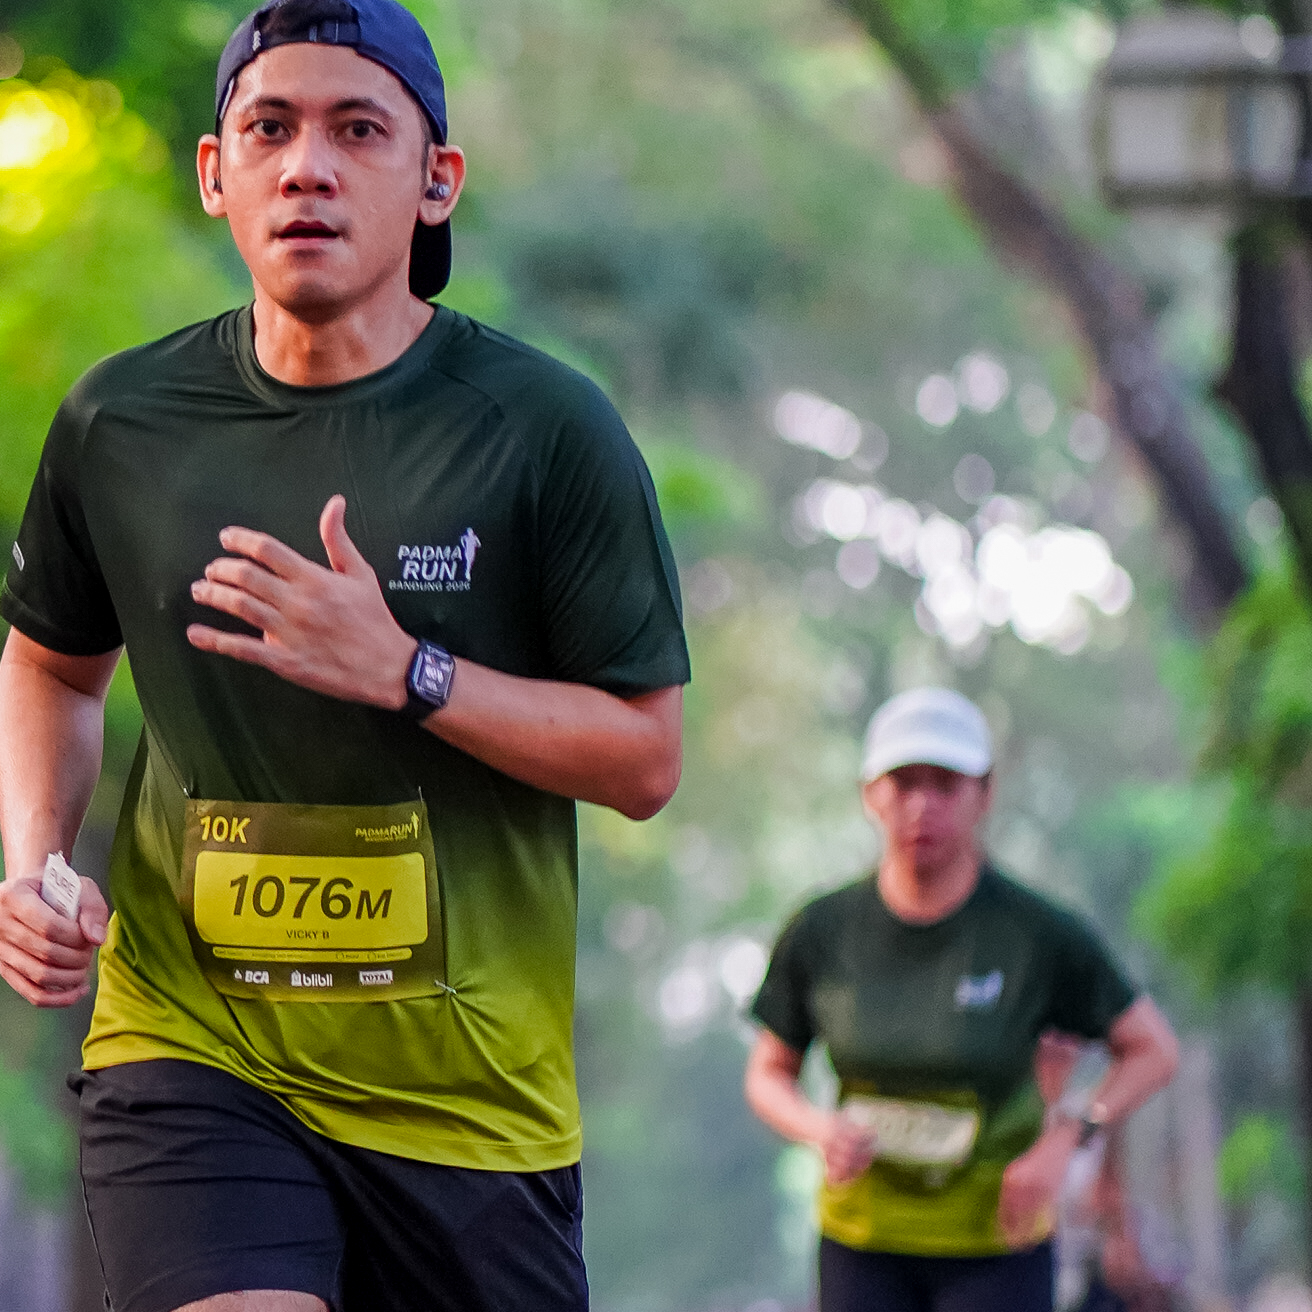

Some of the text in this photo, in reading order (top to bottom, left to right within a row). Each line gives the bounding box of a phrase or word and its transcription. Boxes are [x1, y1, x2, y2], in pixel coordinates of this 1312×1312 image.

[397, 544, 462, 561] PADMA
[403, 560, 458, 581] RUN
[200, 815, 251, 844] 10K
[286, 929, 318, 940] VICKY
[244, 970, 270, 985] BCA
